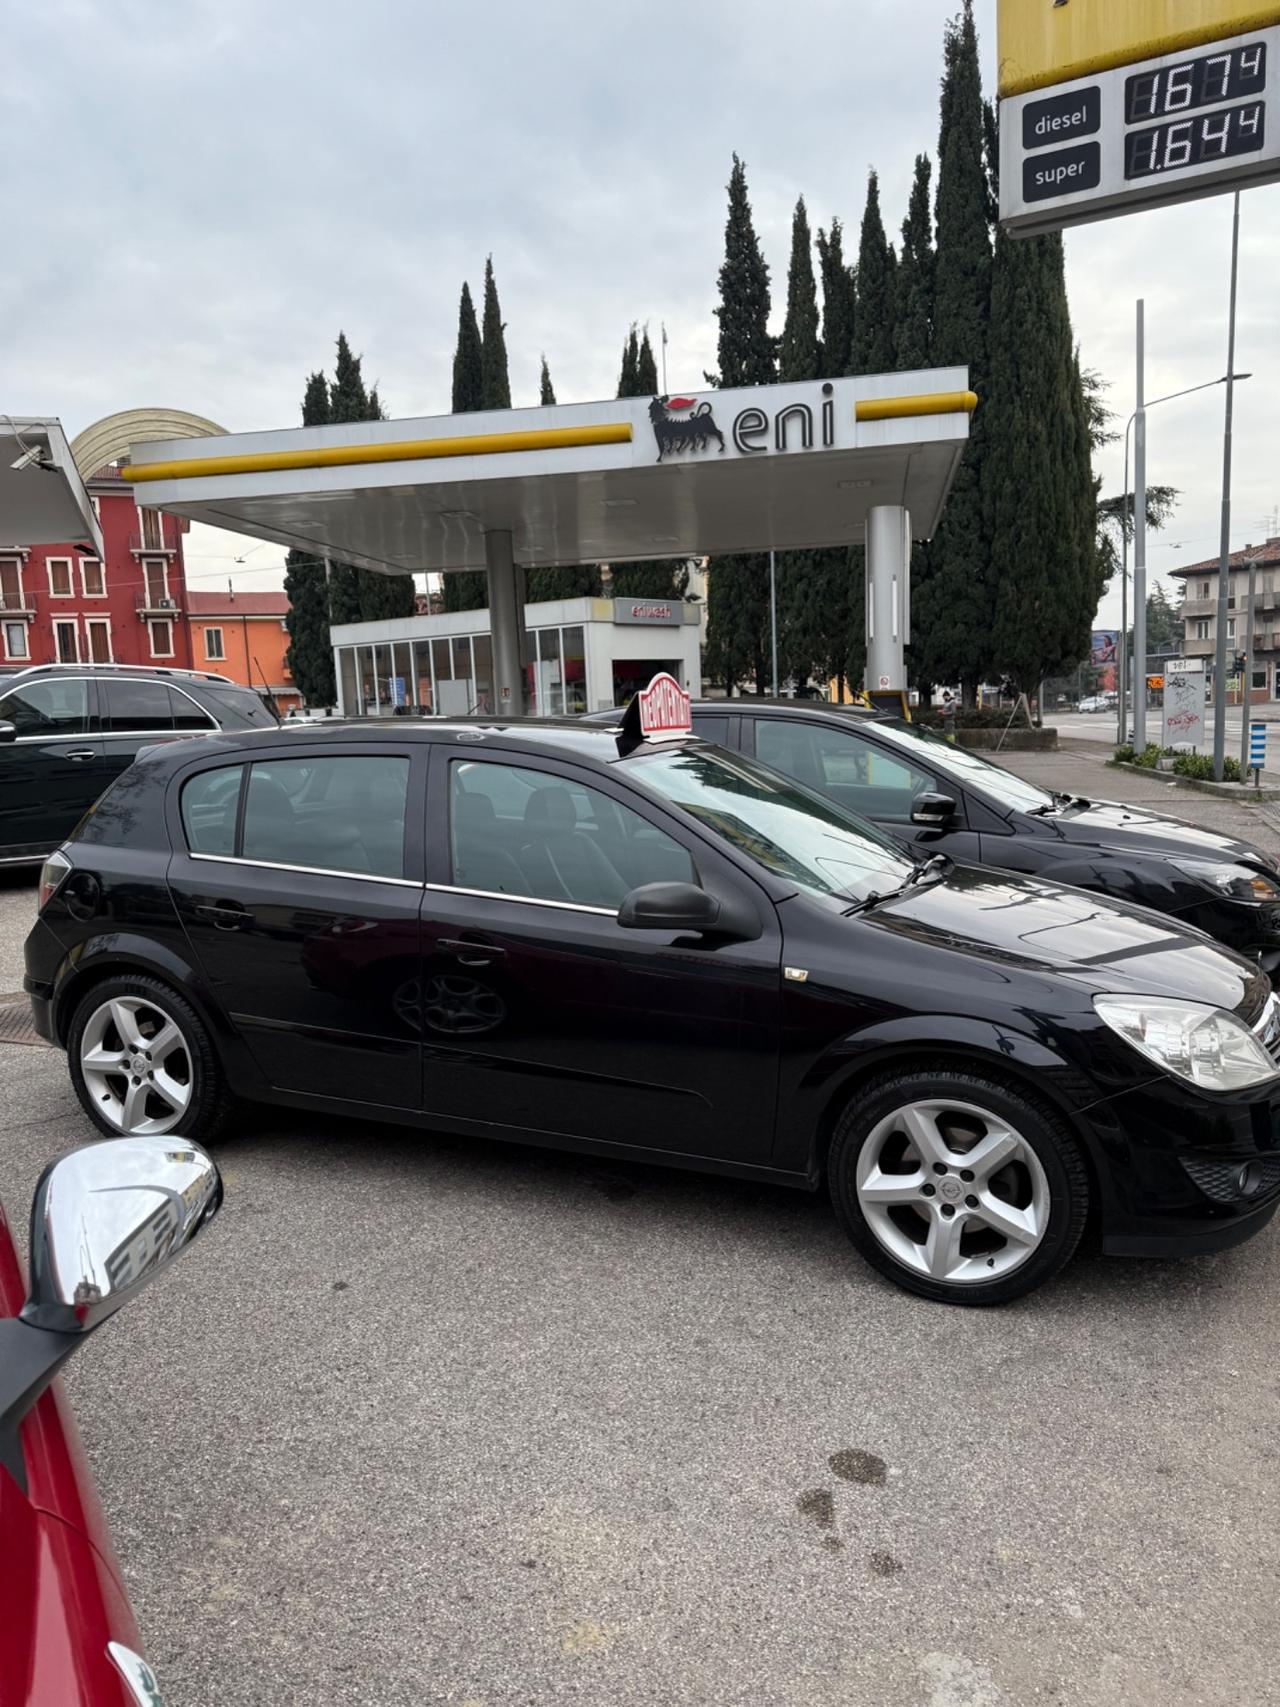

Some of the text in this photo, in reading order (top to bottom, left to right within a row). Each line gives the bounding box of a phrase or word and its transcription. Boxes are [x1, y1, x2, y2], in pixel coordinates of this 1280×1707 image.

[1035, 105, 1087, 135] diesel
[1035, 160, 1086, 185] super
[732, 382, 835, 453] eni
